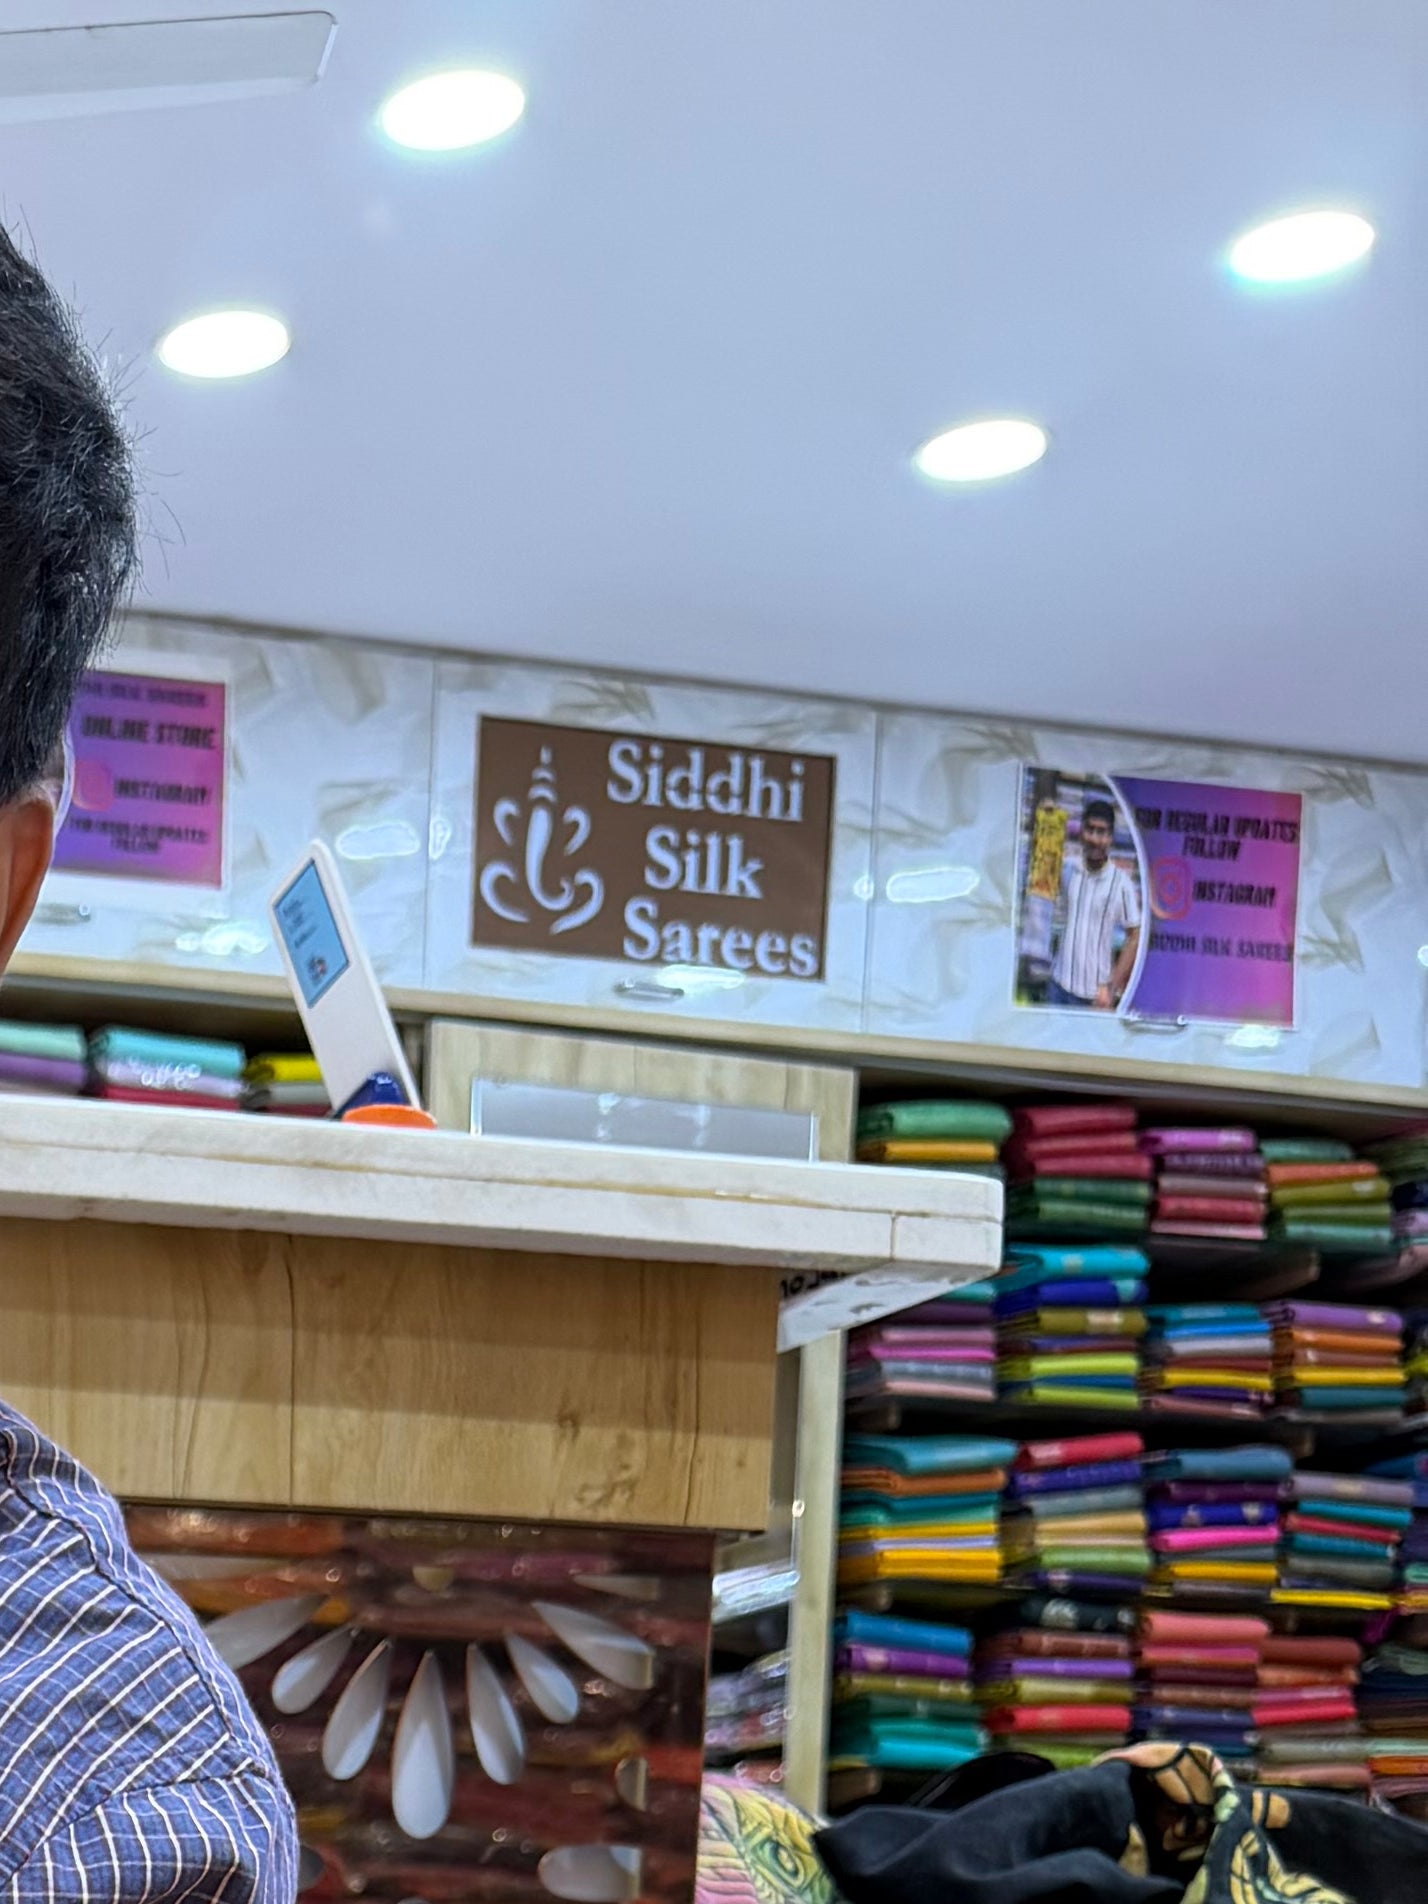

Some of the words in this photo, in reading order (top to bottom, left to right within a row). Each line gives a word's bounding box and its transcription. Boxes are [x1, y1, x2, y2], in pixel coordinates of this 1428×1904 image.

[607, 738, 805, 821] Siddhi
[644, 825, 764, 898] Silk
[1234, 816, 1298, 843] UPDATES
[1193, 879, 1276, 908] INSTAGRAM
[623, 896, 819, 977] Sarees
